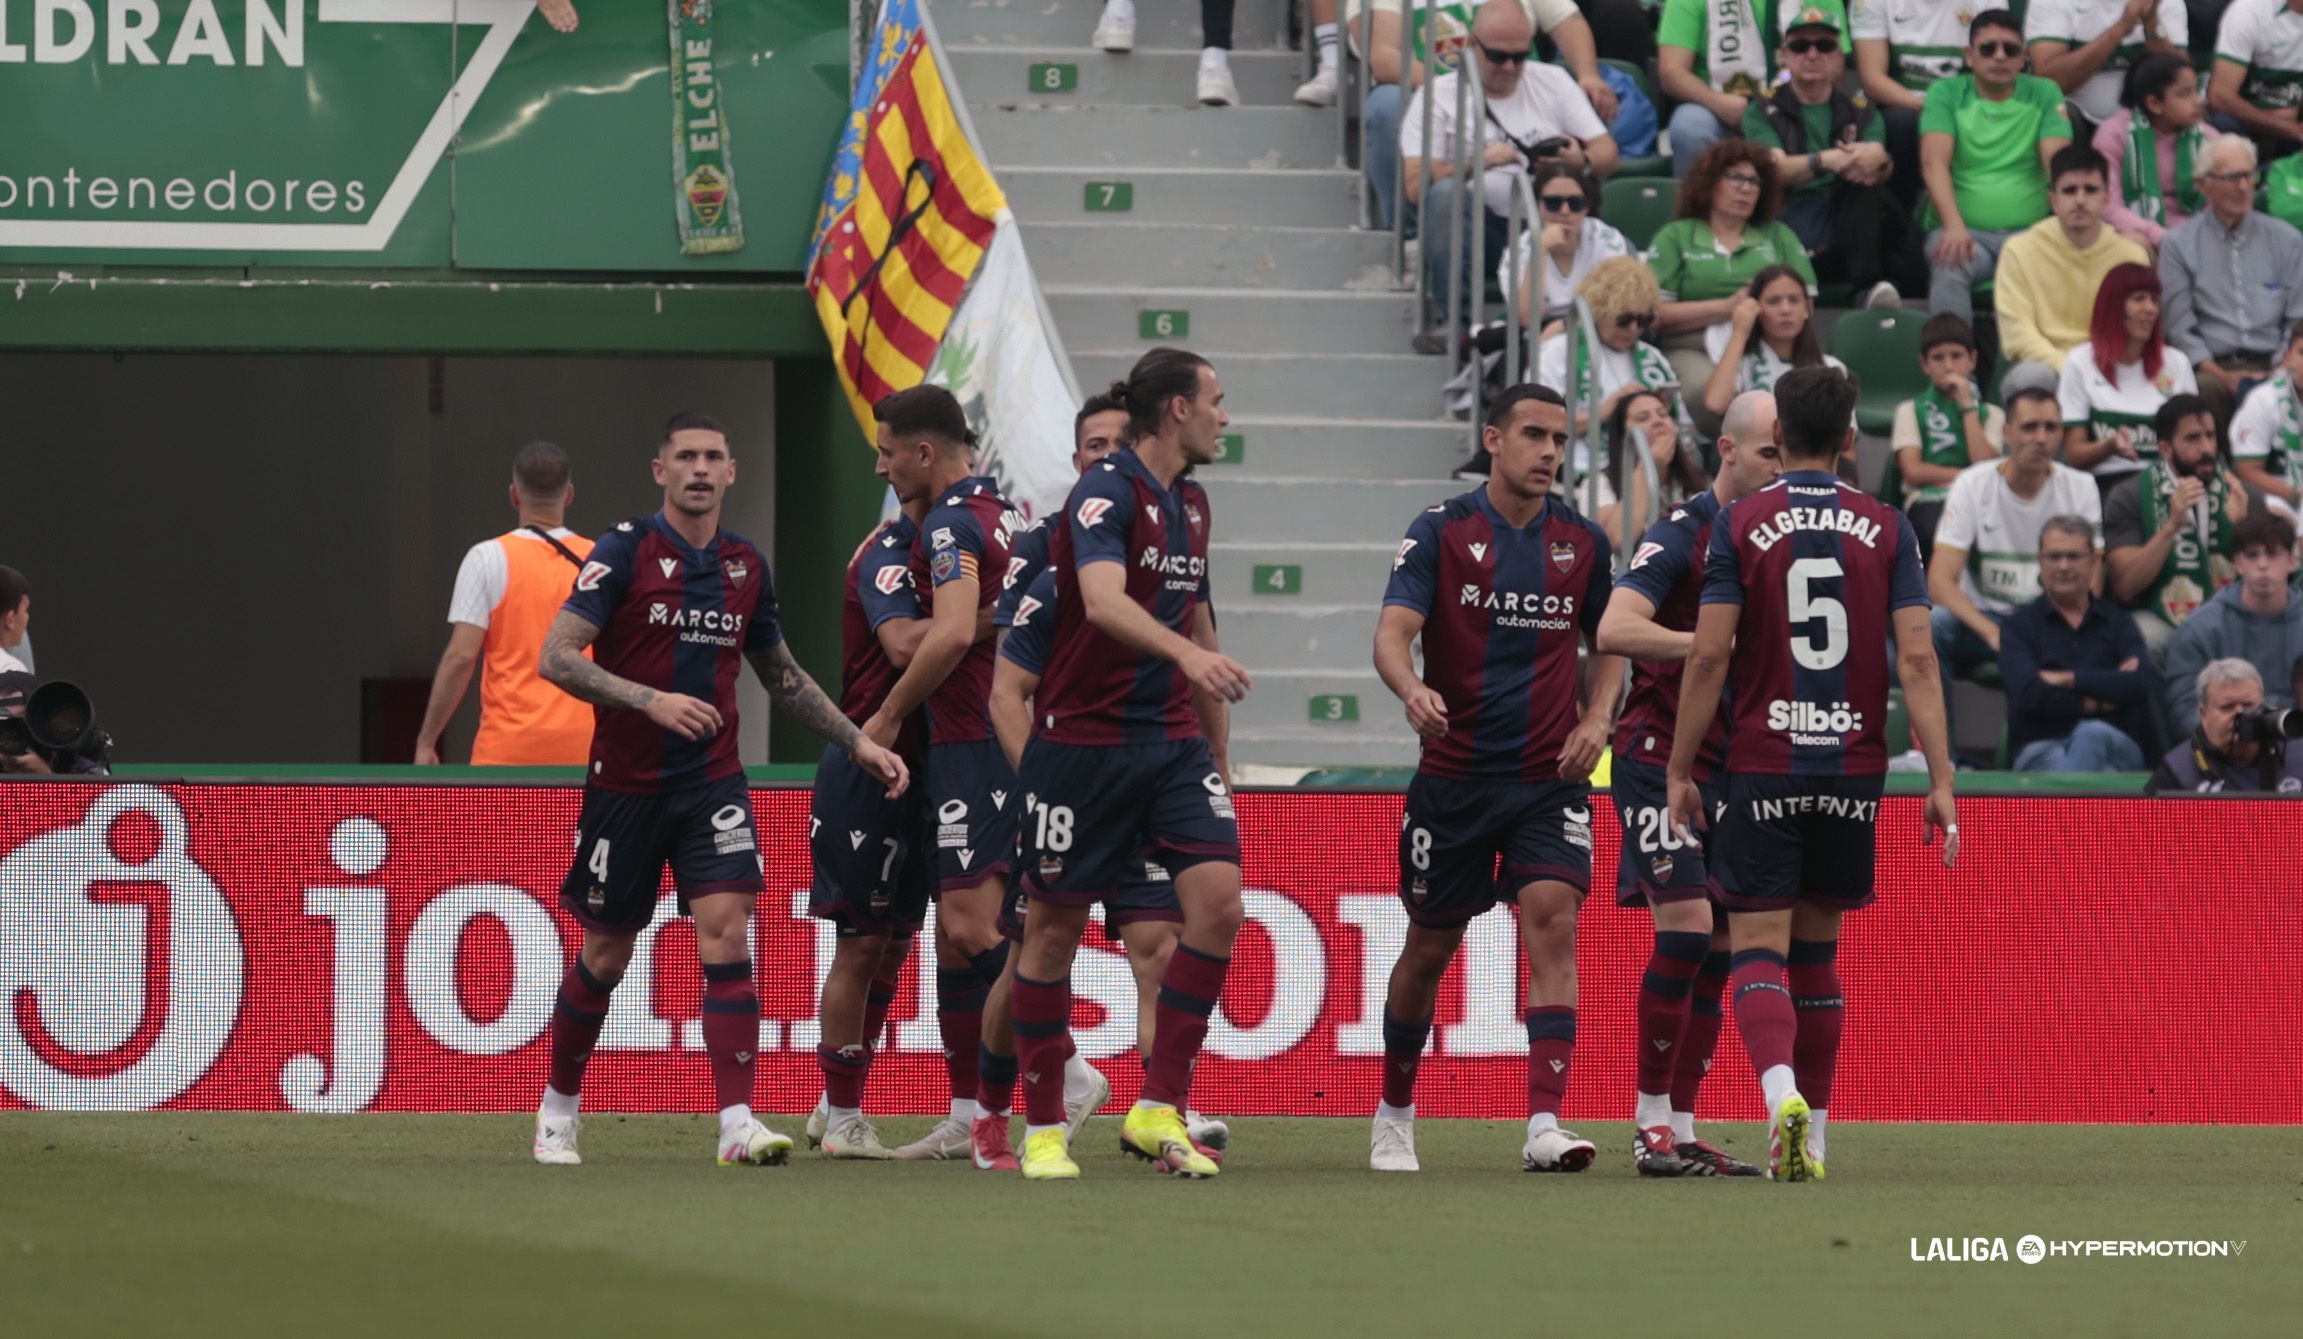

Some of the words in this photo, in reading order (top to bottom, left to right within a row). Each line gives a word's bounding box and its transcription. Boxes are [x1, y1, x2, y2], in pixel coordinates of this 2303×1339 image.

[1045, 68, 1061, 88] 8
[685, 38, 720, 152] ELCHE
[0, 167, 365, 212] ontenedores
[1100, 186, 1115, 206] 7
[1156, 313, 1173, 336] 6
[1213, 437, 1227, 459] 5
[1749, 507, 1882, 551] ELGEZABAL
[1269, 569, 1285, 589] 4
[1460, 583, 1575, 614] MARCOS
[1787, 557, 1848, 670] 5
[648, 602, 743, 632] MARCOS
[1496, 613, 1571, 630] automoción
[1325, 698, 1343, 719] 3
[1790, 733, 1840, 746] Telecom
[1035, 802, 1075, 852] 18
[1638, 806, 1684, 853] 20
[589, 838, 610, 883] 4
[882, 837, 898, 882] 7
[1411, 827, 1432, 871] 8
